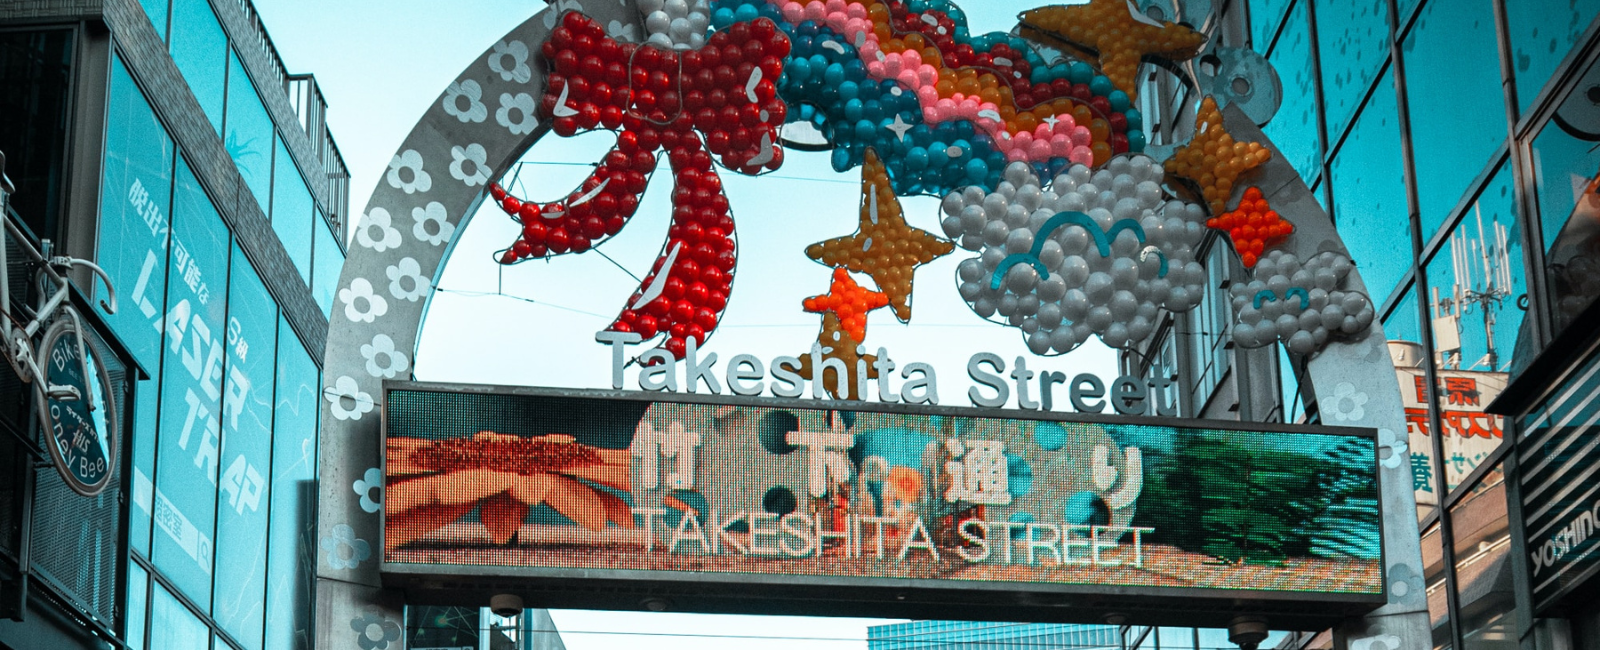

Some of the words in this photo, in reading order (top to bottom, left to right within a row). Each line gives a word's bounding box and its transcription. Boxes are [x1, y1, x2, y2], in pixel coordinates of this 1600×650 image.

[129, 177, 210, 305] 脱出不可能な
[52, 339, 81, 372] Bike
[131, 248, 249, 432] LASER
[594, 330, 940, 405] Takeshita
[966, 351, 1178, 417] Street
[50, 404, 76, 469] oney
[79, 456, 105, 479] Bee
[178, 386, 265, 516] TRAP
[632, 420, 1143, 510] 竹下通り
[631, 507, 940, 564] TAKESHITA
[957, 517, 1156, 569] STREET
